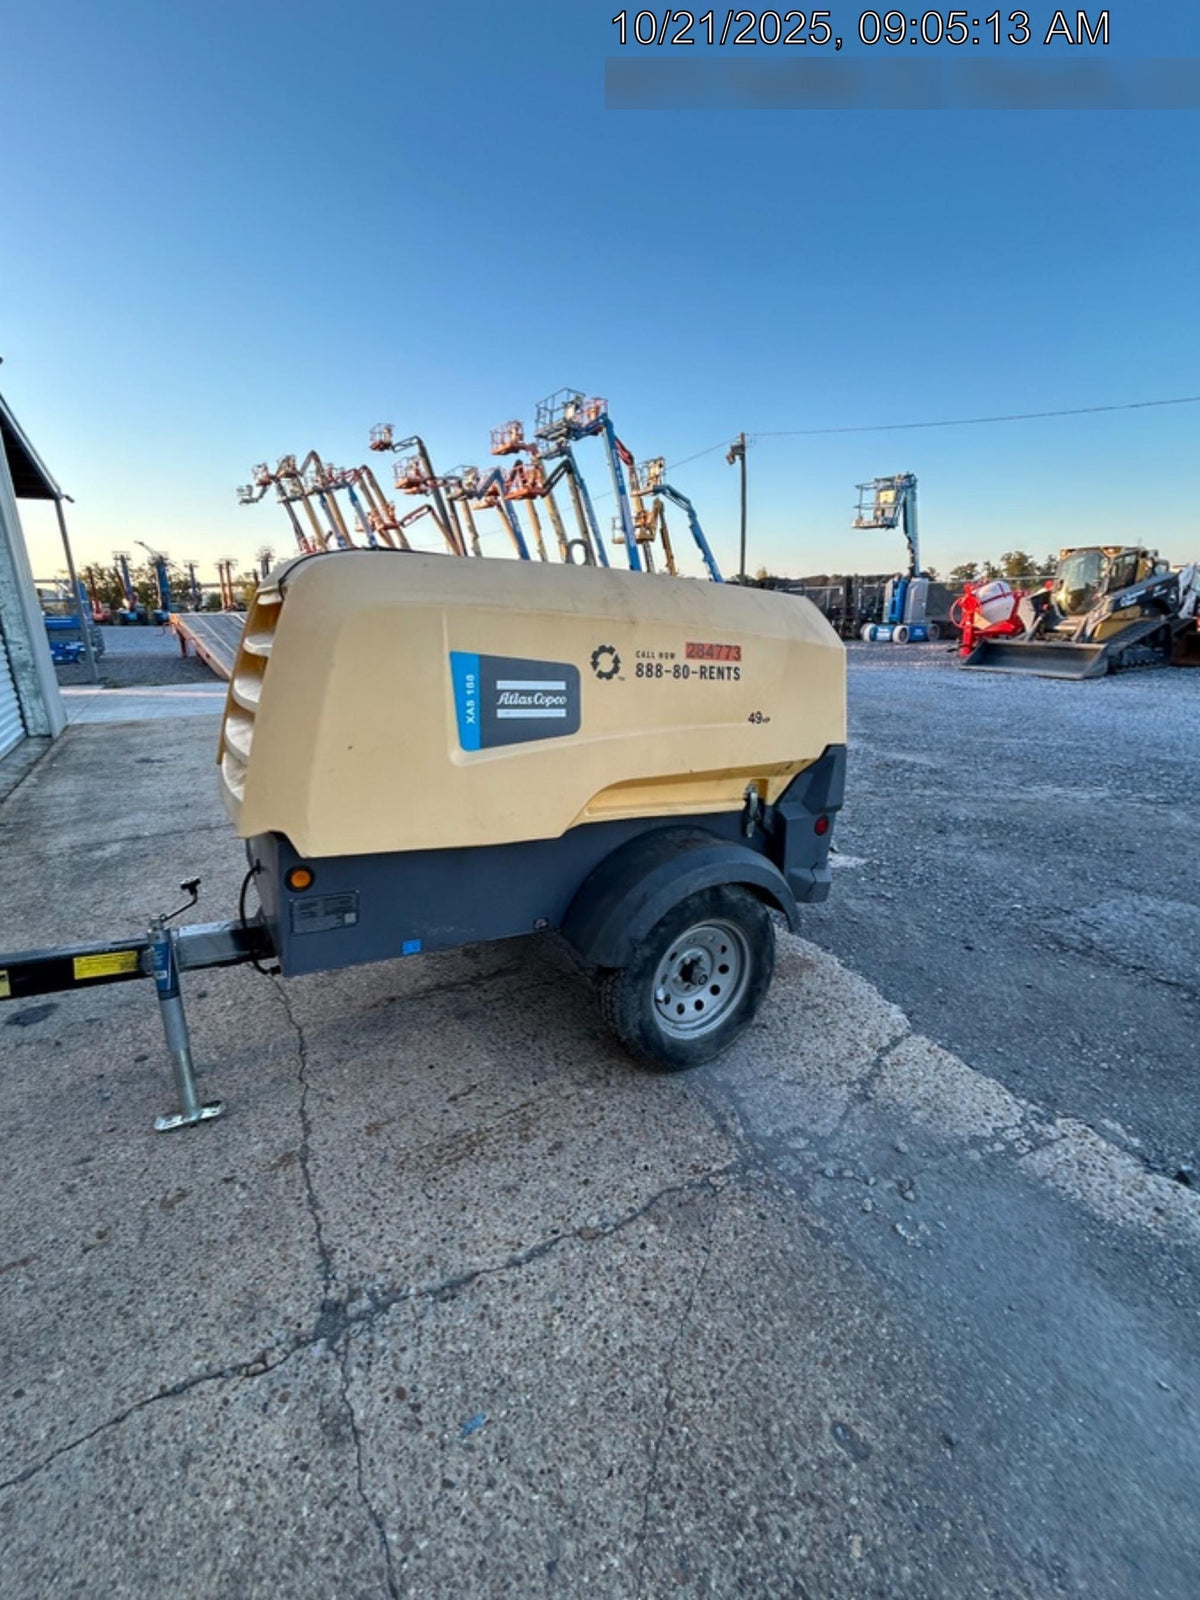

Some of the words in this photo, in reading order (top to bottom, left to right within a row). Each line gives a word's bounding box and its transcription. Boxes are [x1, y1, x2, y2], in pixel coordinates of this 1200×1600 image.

[635, 650, 656, 660] CALL
[658, 651, 676, 660] NOW
[686, 642, 742, 661] 284773
[635, 662, 741, 681] 888-80-RENTS
[496, 691, 532, 705] Atlas
[533, 692, 568, 707] Copco
